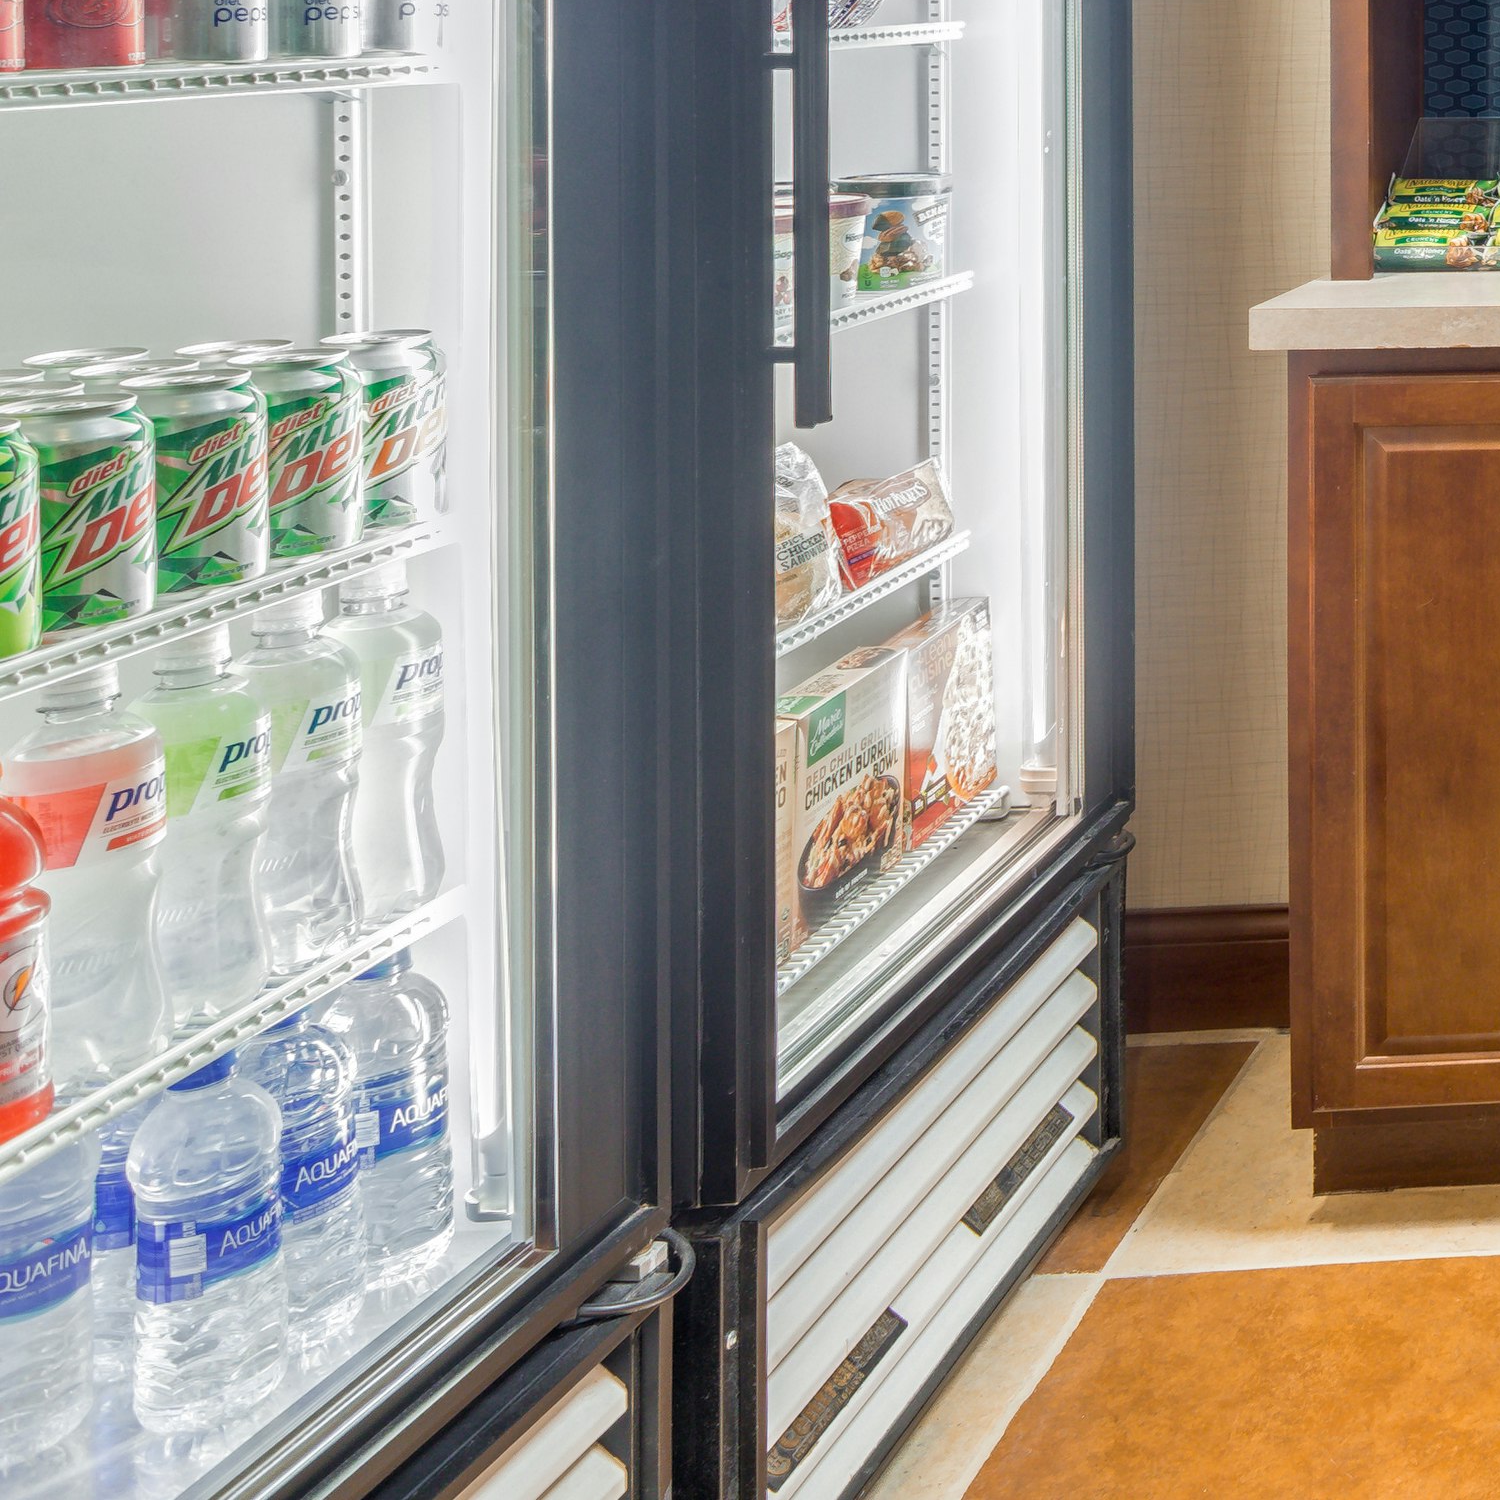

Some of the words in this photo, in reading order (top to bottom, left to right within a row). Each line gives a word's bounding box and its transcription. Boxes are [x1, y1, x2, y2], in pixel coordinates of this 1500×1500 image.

[1413, 195, 1432, 204] Oats
[1408, 216, 1427, 224] Oats
[1394, 248, 1412, 256] Oats
[373, 381, 418, 415] diet
[271, 402, 326, 440] diet
[191, 422, 243, 462] diet
[71, 451, 130, 495] diet
[776, 530, 826, 562] CHICKEN
[804, 761, 853, 812] CHICKEN
[855, 734, 900, 777] BURRITO
[805, 764, 827, 790] RED
[829, 745, 859, 776] CHILI
[872, 755, 900, 779] BOWL
